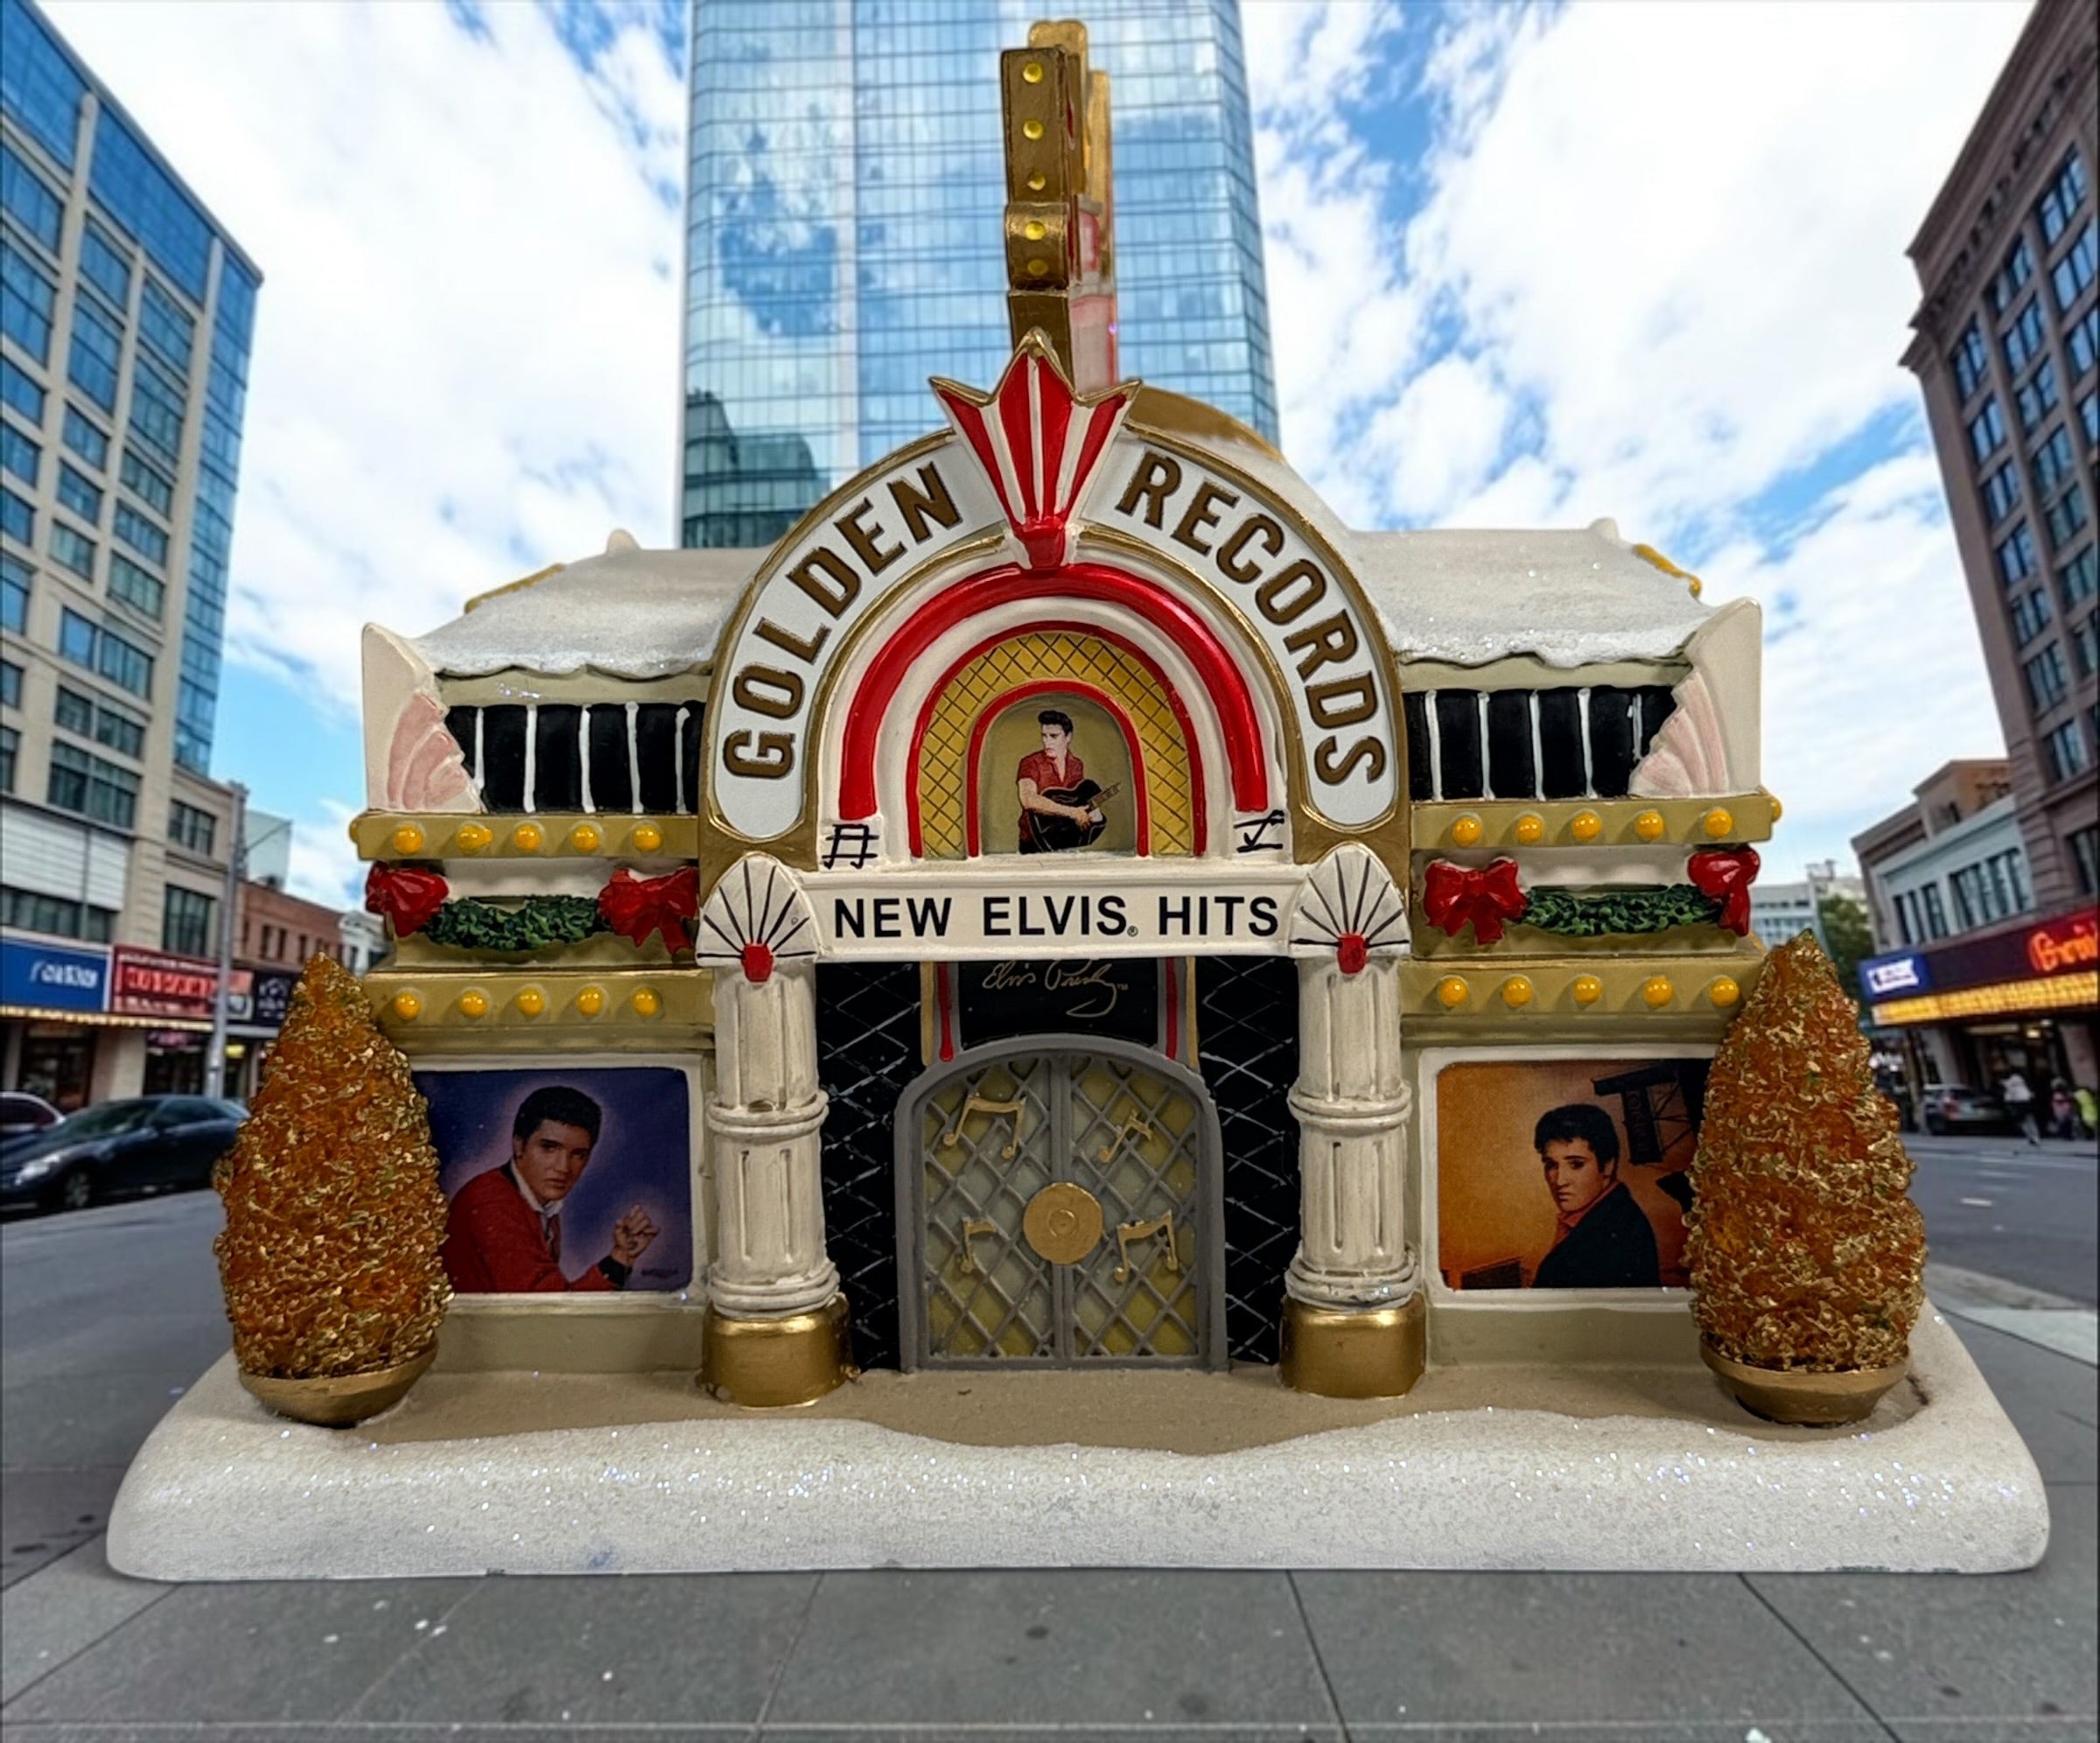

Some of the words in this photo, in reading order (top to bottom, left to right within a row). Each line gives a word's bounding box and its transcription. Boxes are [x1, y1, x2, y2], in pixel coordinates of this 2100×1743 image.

[723, 461, 962, 780] GOLDEN
[1116, 451, 1387, 786] RECORDS
[834, 898, 952, 937] NEW
[1158, 896, 1278, 937] HITS
[982, 959, 1036, 990] Elvis
